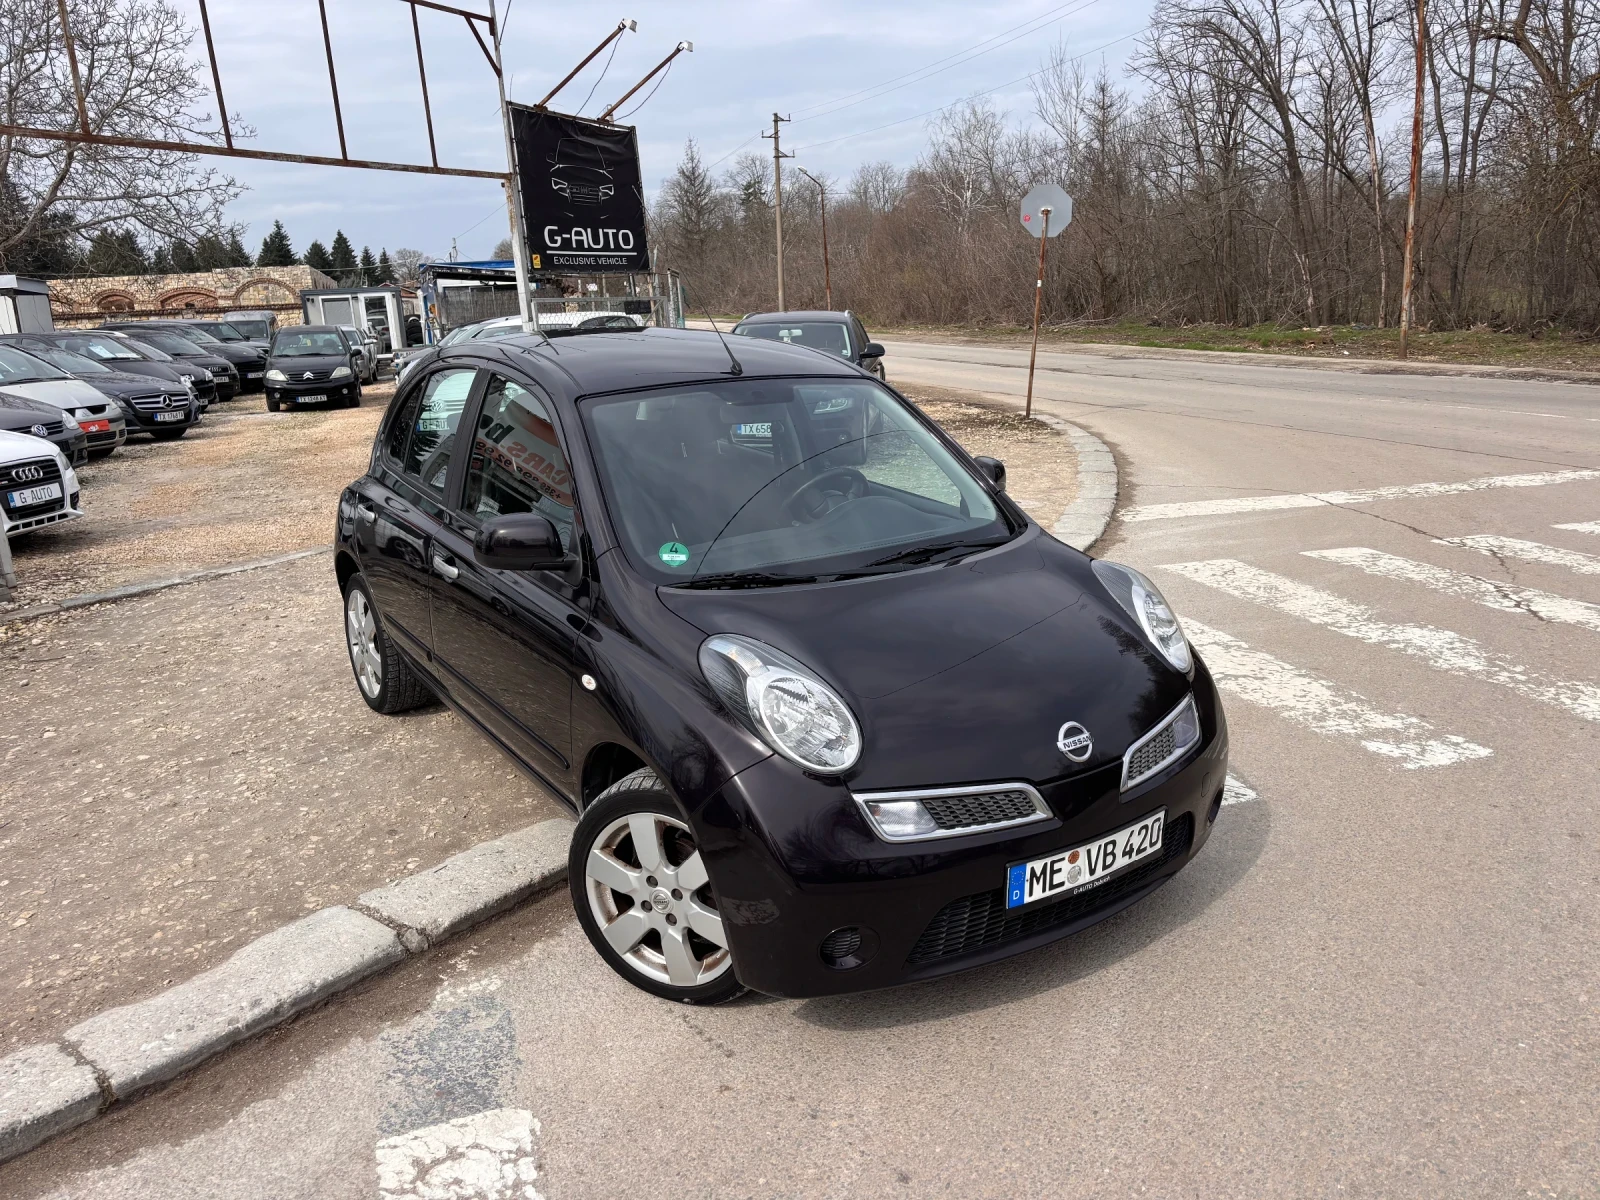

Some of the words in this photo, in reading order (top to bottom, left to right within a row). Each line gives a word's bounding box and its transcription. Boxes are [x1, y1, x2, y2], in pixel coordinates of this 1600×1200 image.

[544, 225, 634, 250] G-AUTO
[553, 256, 596, 265] EXCLUSIVE
[597, 257, 628, 265] VEHICLE
[742, 424, 754, 434] TX
[18, 486, 53, 504] G-AUTO
[669, 542, 679, 553] 4
[1062, 735, 1095, 749] NISSAN
[1013, 889, 1020, 900] D
[1028, 857, 1066, 897] ME
[1086, 839, 1117, 876] VB
[1121, 816, 1162, 860] 420
[1073, 883, 1093, 895] G-AUTO
